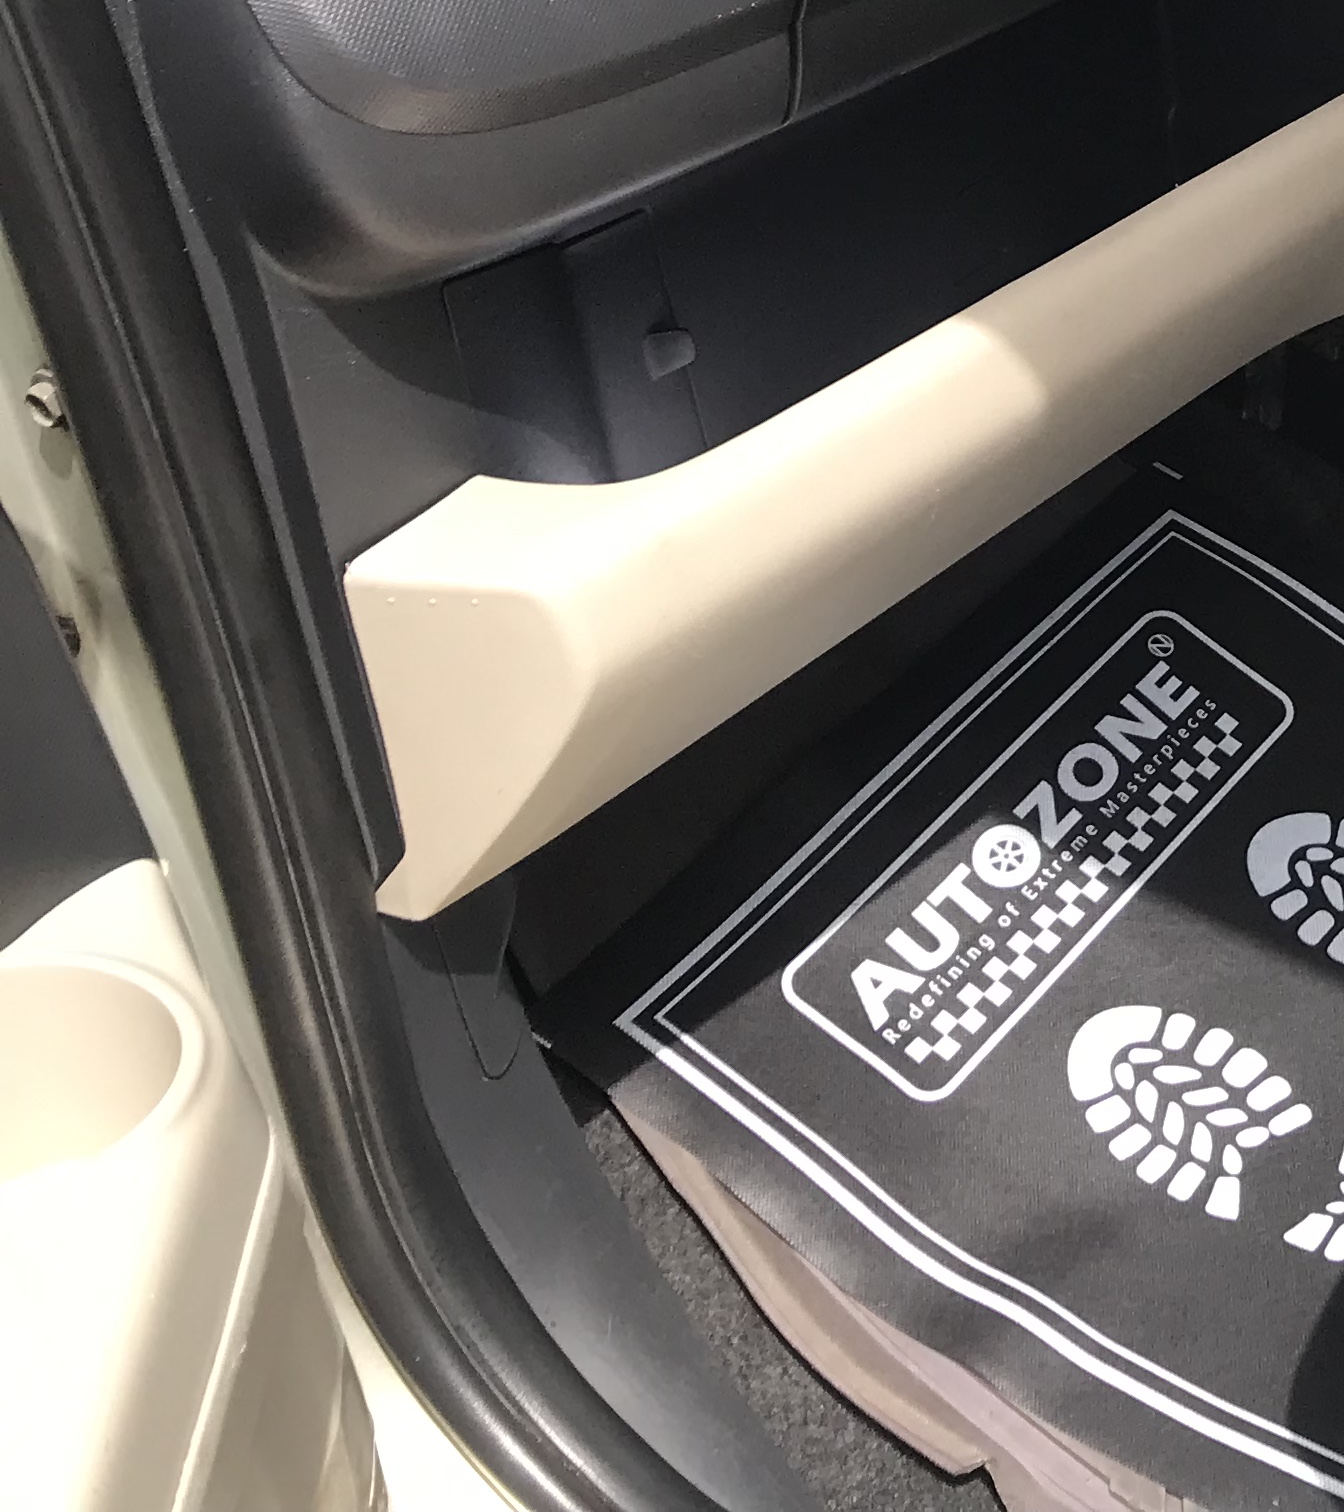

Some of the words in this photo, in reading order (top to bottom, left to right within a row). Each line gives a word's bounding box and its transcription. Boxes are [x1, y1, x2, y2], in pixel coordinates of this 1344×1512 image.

[881, 932, 996, 1046] Redefining
[997, 900, 1021, 929] of
[1021, 824, 1098, 901] Extreme
[1099, 698, 1218, 819] Masterpieces
